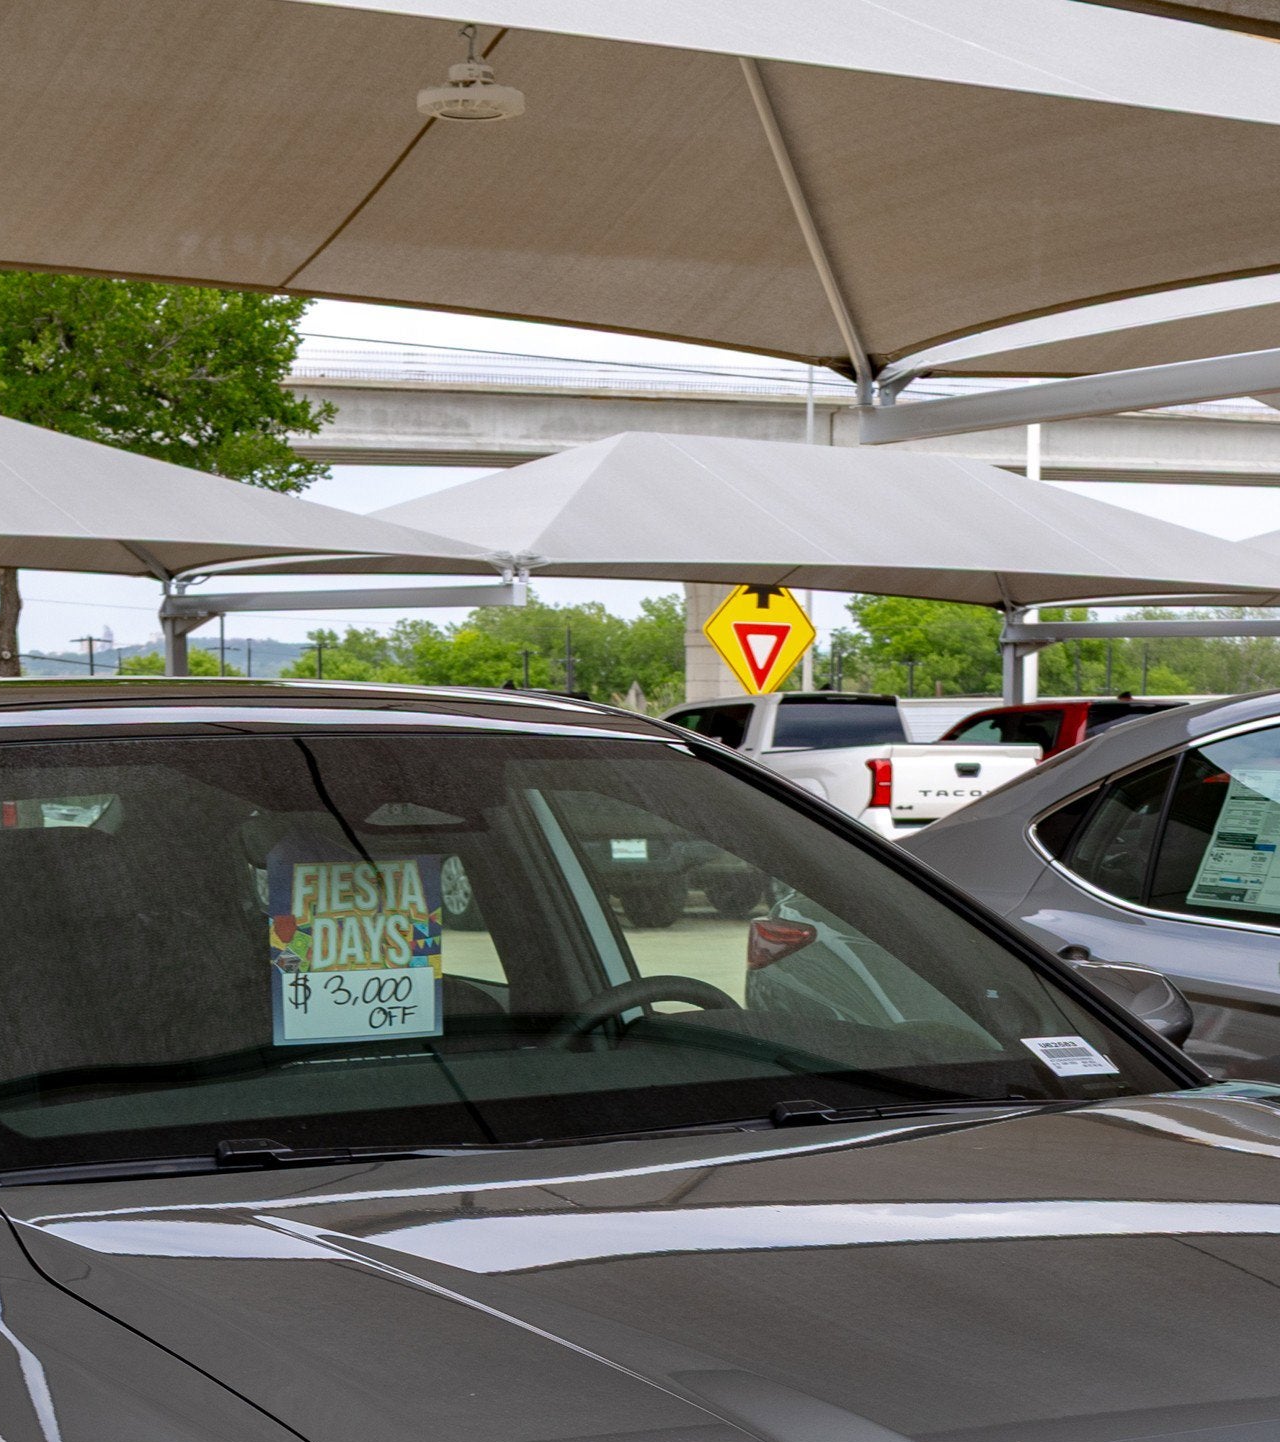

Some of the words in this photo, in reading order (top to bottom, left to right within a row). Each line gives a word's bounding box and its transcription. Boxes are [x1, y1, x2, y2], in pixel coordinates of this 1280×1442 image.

[918, 789, 992, 798] TACO
[291, 861, 429, 919] FIESTA
[310, 913, 413, 970] DAYS
[288, 972, 312, 1014] $
[323, 975, 412, 1006] 3,000
[368, 1005, 419, 1029] OFF
